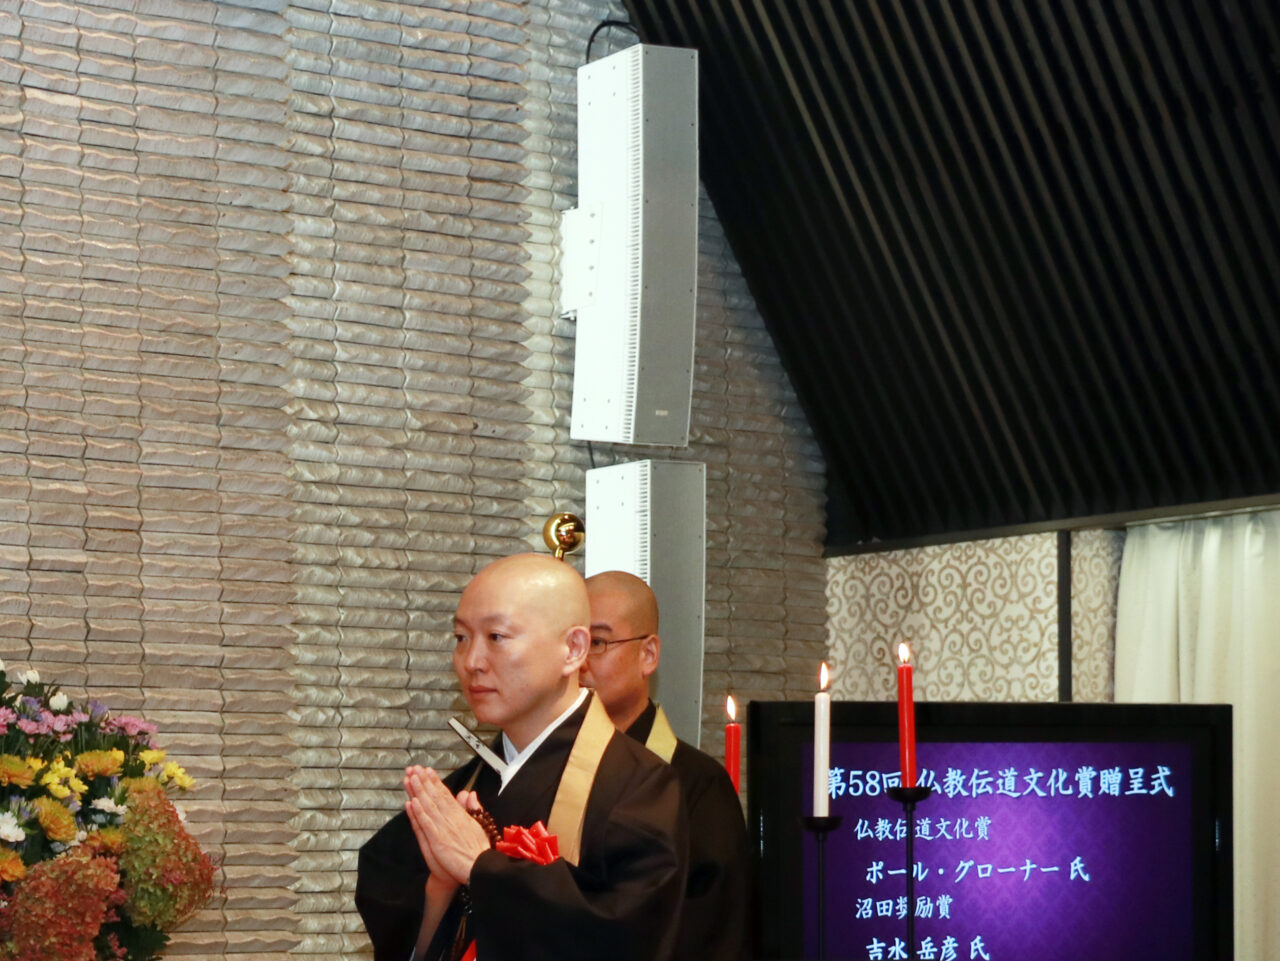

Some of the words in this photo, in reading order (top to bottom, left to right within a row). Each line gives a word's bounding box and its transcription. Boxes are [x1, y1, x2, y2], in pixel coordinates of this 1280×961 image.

[854, 816, 992, 841] 仏教伝道文化賞
[866, 859, 1060, 884] ポール・グローナー
[1070, 856, 1090, 882] 氏
[970, 935, 990, 961] 氏
